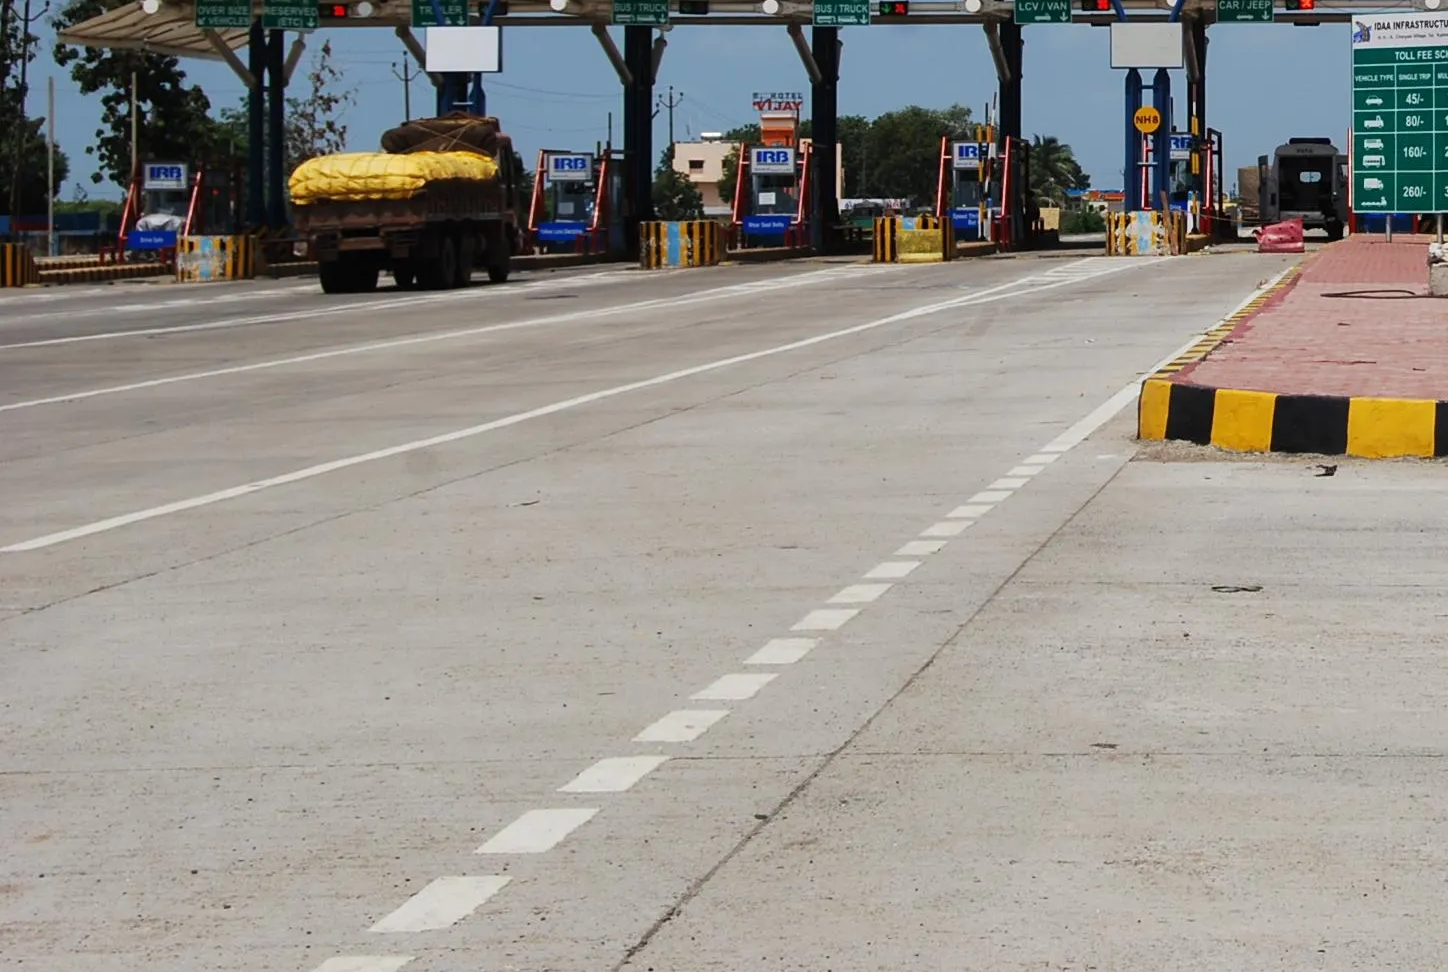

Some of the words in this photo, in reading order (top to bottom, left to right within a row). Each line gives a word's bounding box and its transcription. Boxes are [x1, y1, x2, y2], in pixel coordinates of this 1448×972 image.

[639, 3, 667, 12] TRUCK
[815, 4, 832, 13] BUS
[839, 4, 868, 13] TRUCK
[1219, 0, 1240, 9] CAR
[1248, 0, 1272, 9] JEEP
[198, 6, 226, 15] OVER
[228, 6, 249, 15] SIZE
[263, 7, 318, 17] RESERVED
[1374, 21, 1391, 30] IDAA
[1395, 51, 1415, 60] TOLL
[1417, 50, 1432, 60] FEE
[1406, 93, 1424, 104] 45/-
[752, 98, 803, 110] VIJAY
[1406, 116, 1424, 126] 80/-
[756, 151, 789, 163] IRB
[1403, 146, 1427, 158] 160/-
[554, 158, 586, 170] IRB
[151, 166, 182, 179] IRB
[1403, 186, 1427, 197] 260/-
